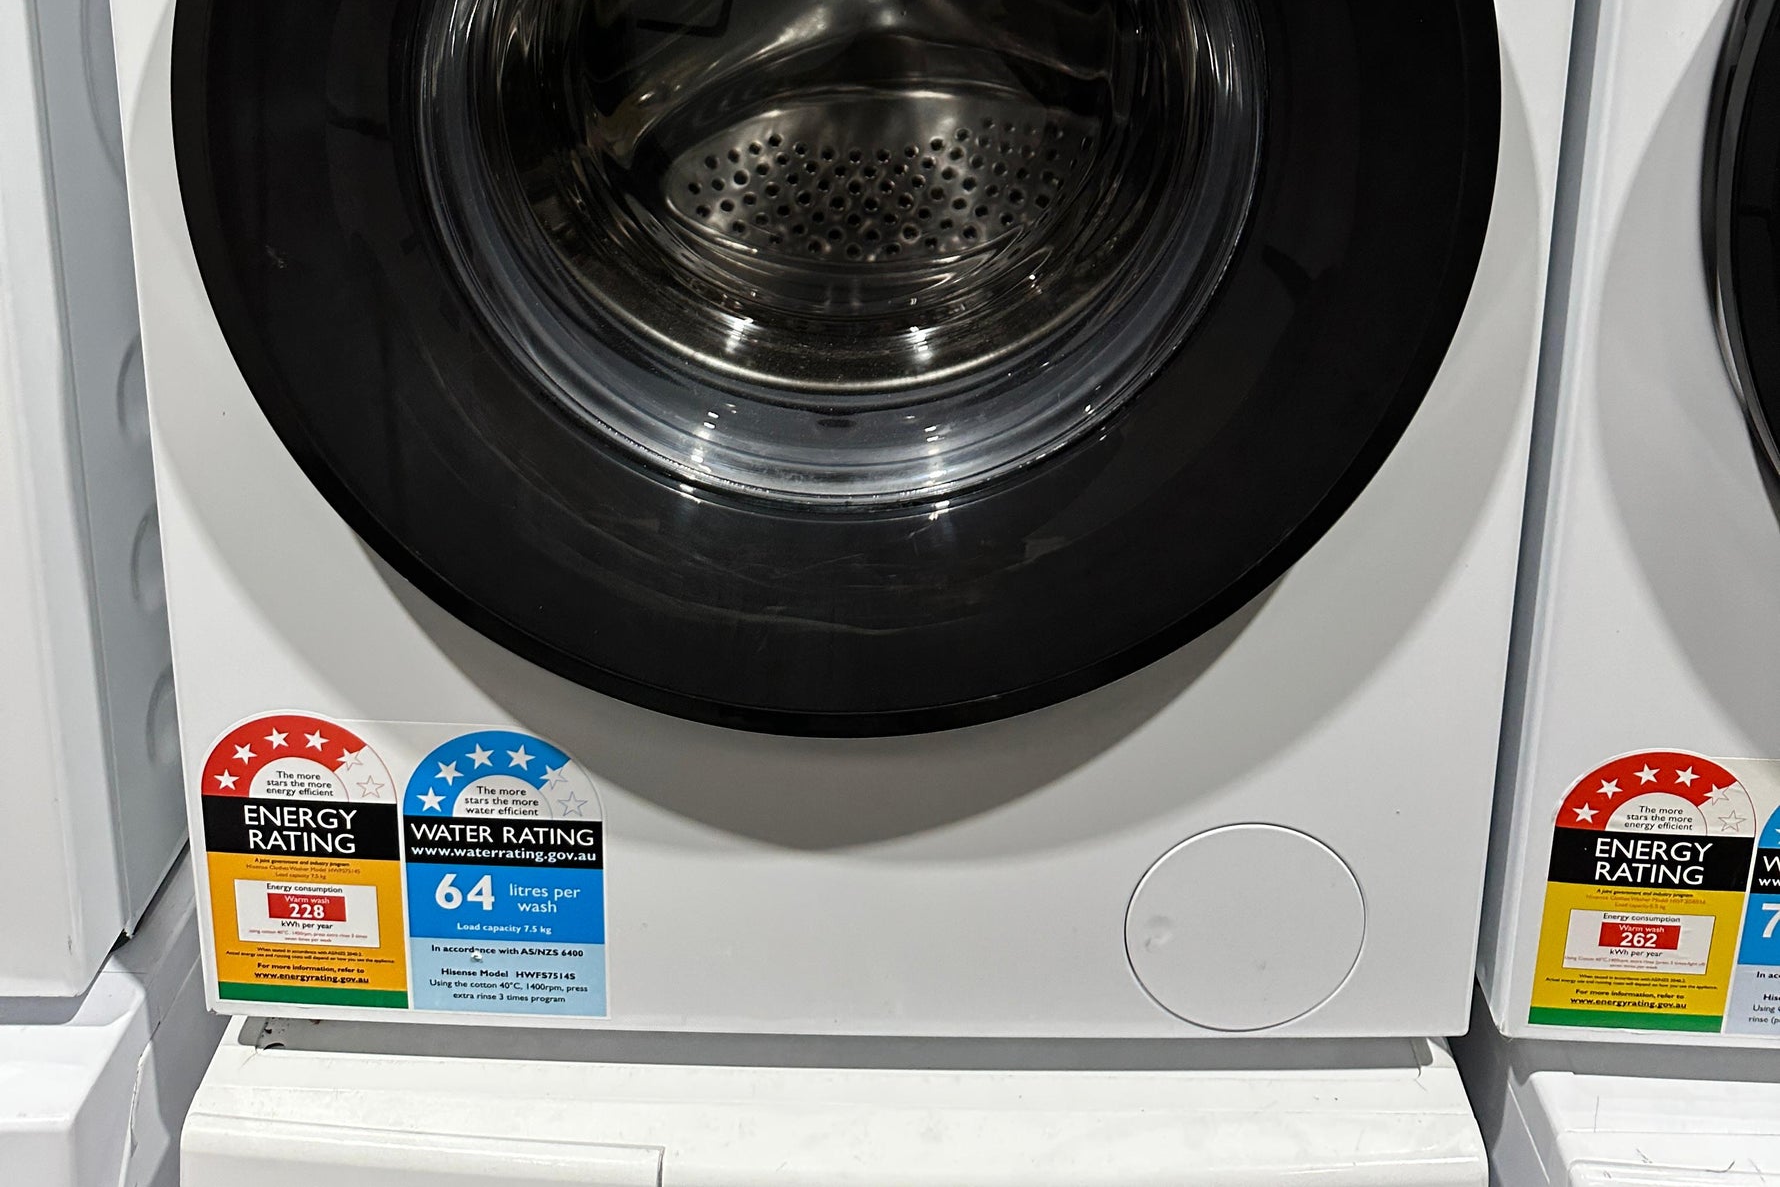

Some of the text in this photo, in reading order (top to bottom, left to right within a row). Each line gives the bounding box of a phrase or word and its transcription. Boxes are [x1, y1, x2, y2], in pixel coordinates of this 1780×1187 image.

[276, 770, 321, 781] The more
[266, 779, 332, 789] stars the more
[266, 787, 334, 798] energy efficient
[476, 785, 527, 796] The more
[464, 796, 539, 807] stars the more
[243, 804, 358, 830] ENERGY
[465, 806, 539, 817] water efficient
[410, 823, 594, 846] WATER RATING
[248, 829, 356, 854] RATING
[411, 846, 597, 863] www.waterrating.gov.au
[1594, 837, 1713, 863] ENERGY
[1594, 861, 1705, 885] RATING
[266, 883, 343, 894] Energy consumption
[435, 873, 495, 911] 64
[509, 883, 581, 900] litres per
[284, 895, 330, 905] Warm wash
[517, 899, 557, 913] wash
[288, 903, 325, 919] 228
[1603, 913, 1681, 924] Energy consumption
[281, 920, 301, 928] kWh
[302, 922, 315, 930] per
[456, 922, 552, 934] Load capacity 7.5 kg
[1619, 924, 1644, 932] Warm
[1619, 932, 1658, 948] 262
[431, 944, 441, 952] In
[498, 947, 519, 956] with
[520, 948, 559, 957] AS/NZS
[561, 949, 584, 957] 6400
[254, 971, 369, 984] www.energyrating.gov.au
[441, 968, 576, 980] Hisense Model HWFS7514S
[1756, 970, 1766, 978] In
[429, 979, 453, 988] Using
[454, 980, 468, 988] the
[525, 983, 565, 994] 1400rpm,
[476, 993, 497, 1001] rinse
[530, 996, 566, 1004] program
[1570, 996, 1687, 1010] www.energyrating.gov.au
[1753, 1004, 1775, 1013] Using
